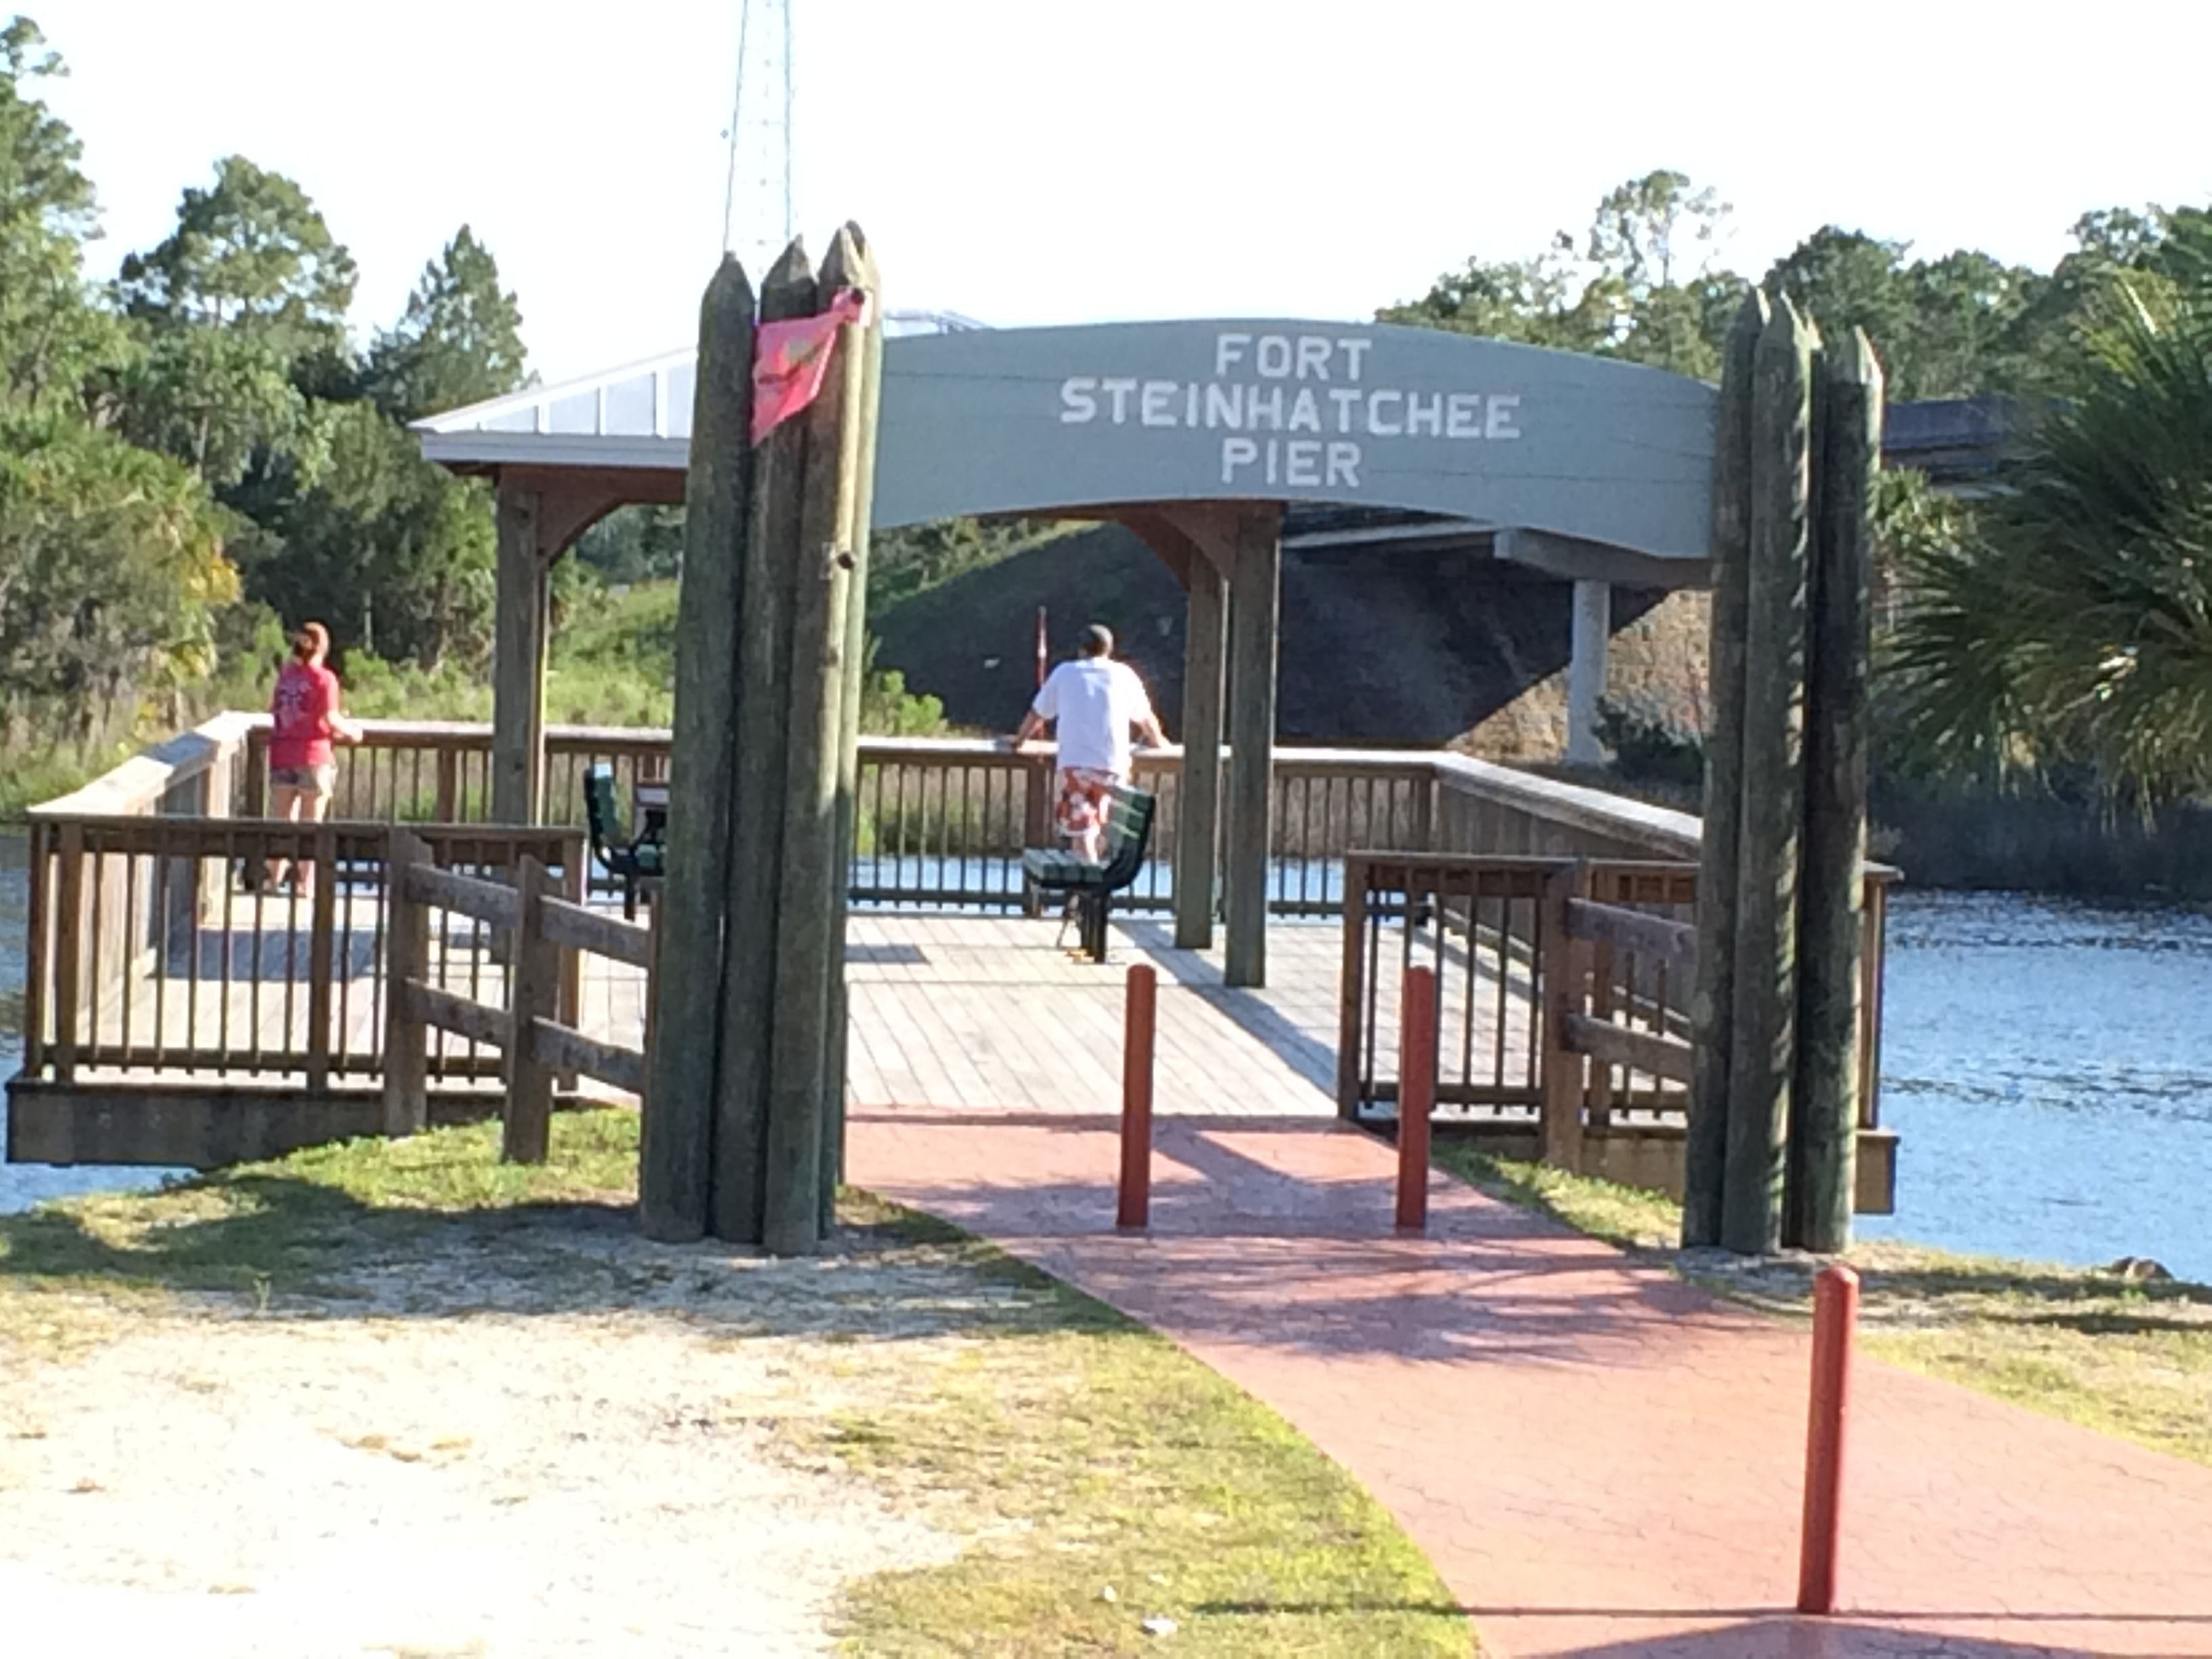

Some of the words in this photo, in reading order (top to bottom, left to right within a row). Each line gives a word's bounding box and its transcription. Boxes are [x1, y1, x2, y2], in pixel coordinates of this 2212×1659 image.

[1216, 333, 1372, 381] FORT
[1060, 377, 1521, 439] STEINHATCHEE
[1221, 437, 1361, 487] PIER
